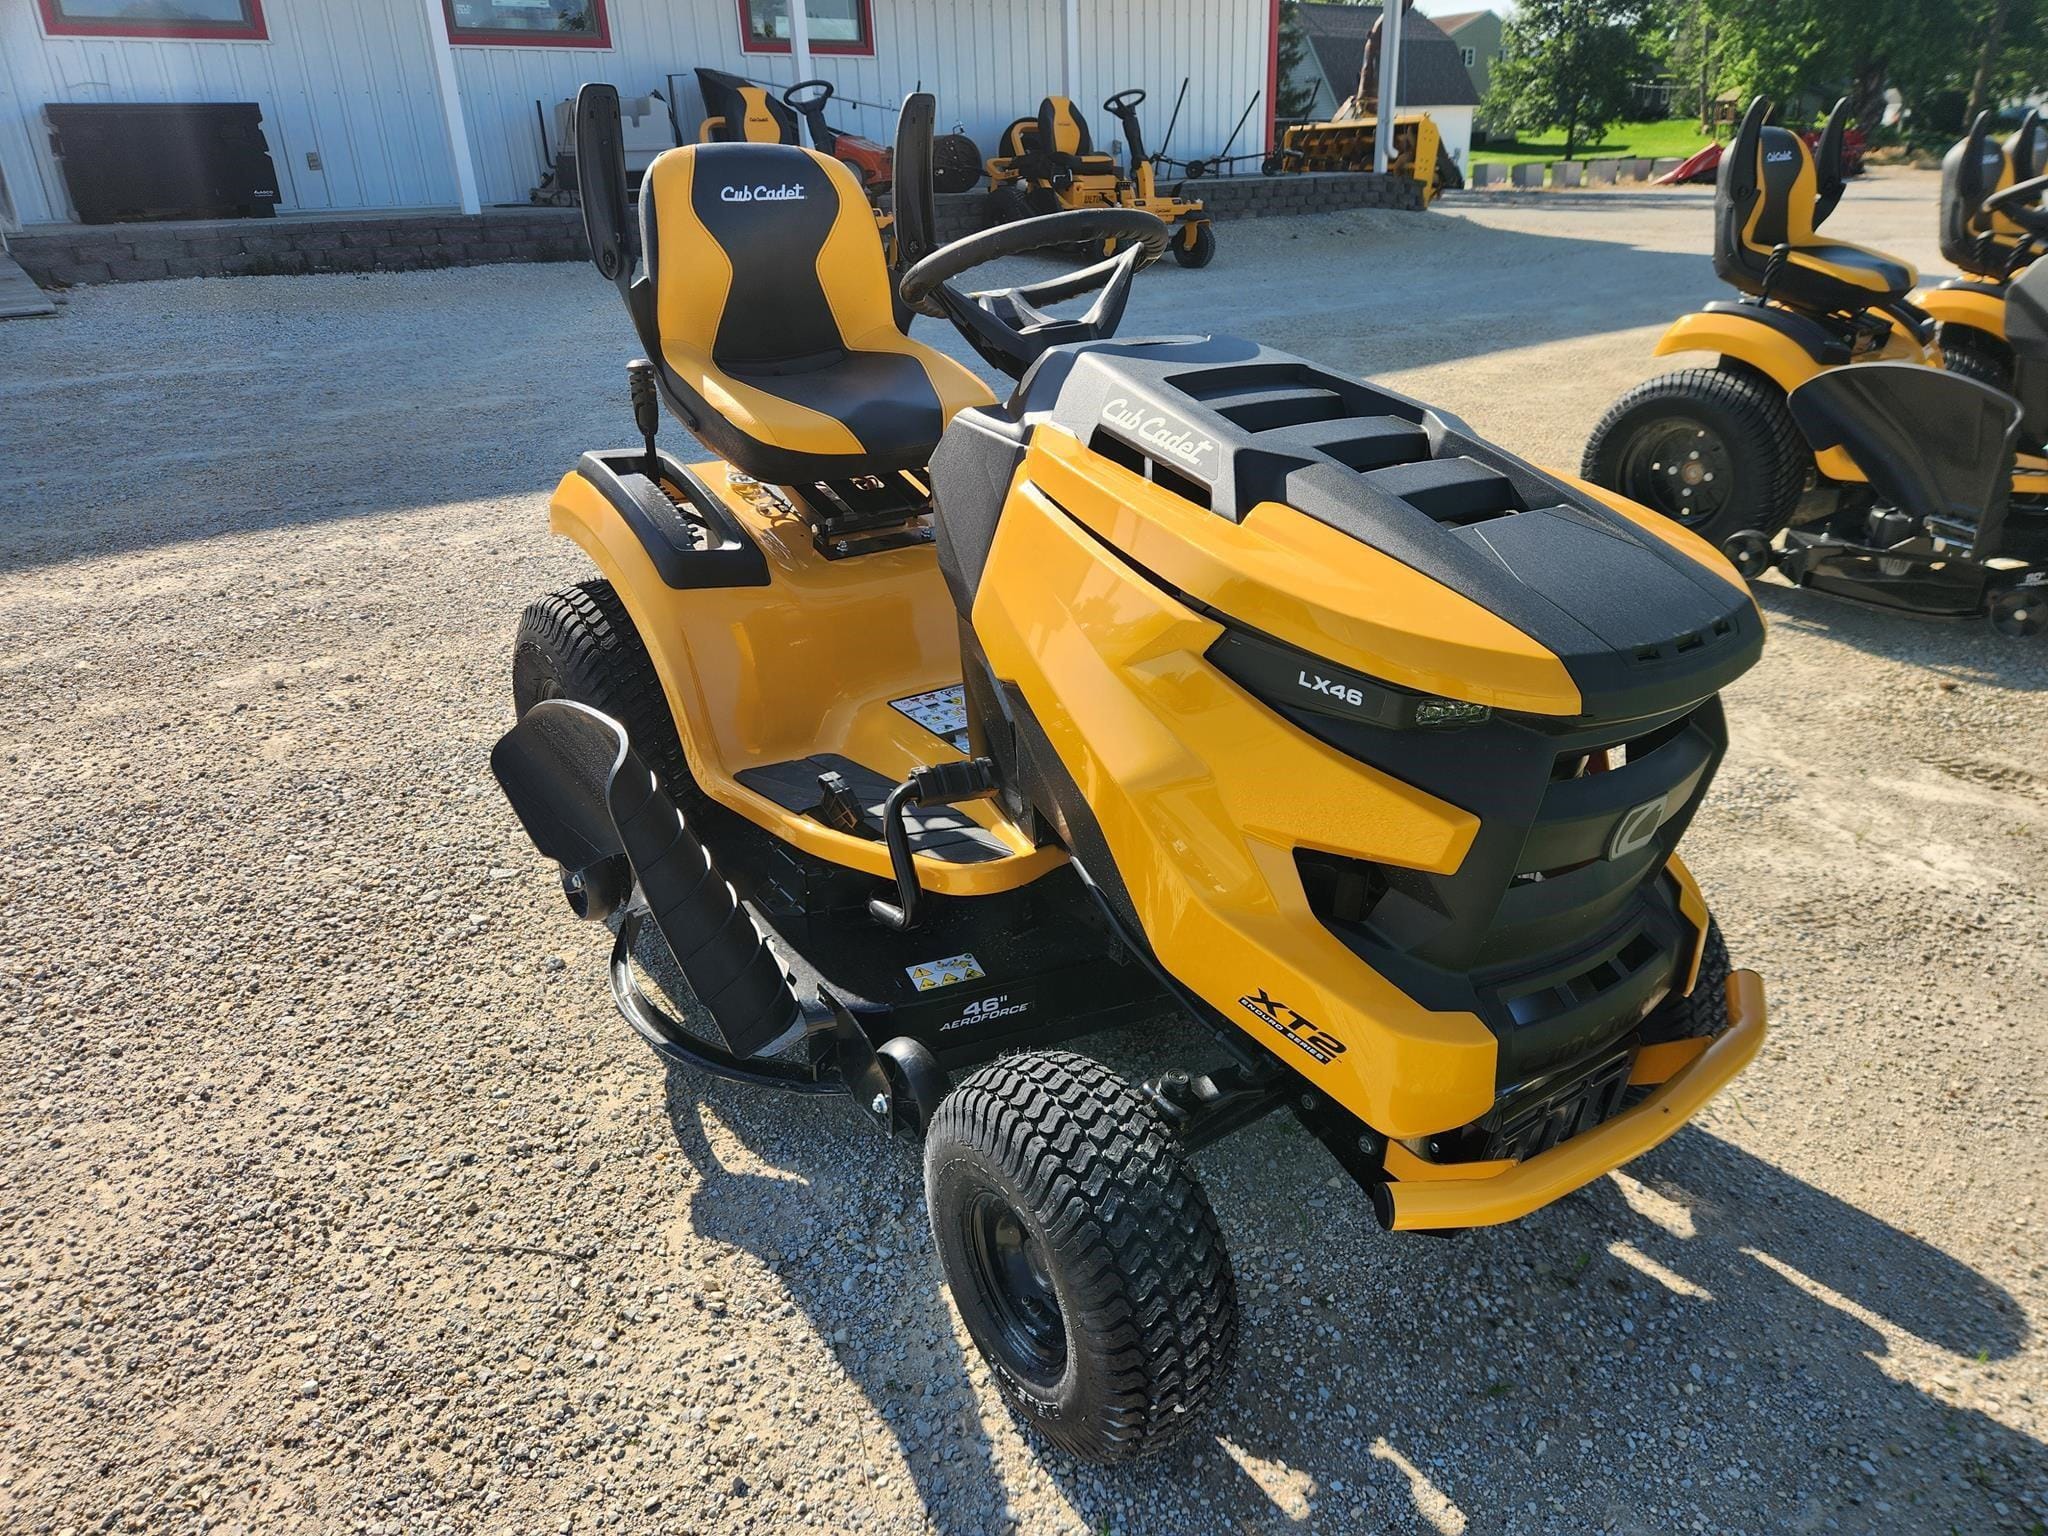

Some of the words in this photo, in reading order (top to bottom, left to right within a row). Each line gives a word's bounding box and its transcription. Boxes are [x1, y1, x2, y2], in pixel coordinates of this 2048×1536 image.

[720, 185, 753, 202] Cub
[753, 183, 805, 201] Cadet
[1102, 398, 1147, 431] Cub
[1138, 417, 1214, 465] Cadet
[1298, 670, 1364, 706] LX46
[940, 1002, 1030, 1031] AEROFORCE
[963, 994, 1008, 1016] 46"
[1245, 987, 1347, 1059] XT2
[1240, 999, 1284, 1031] ENDURO
[1286, 1032, 1325, 1061] SERIES
